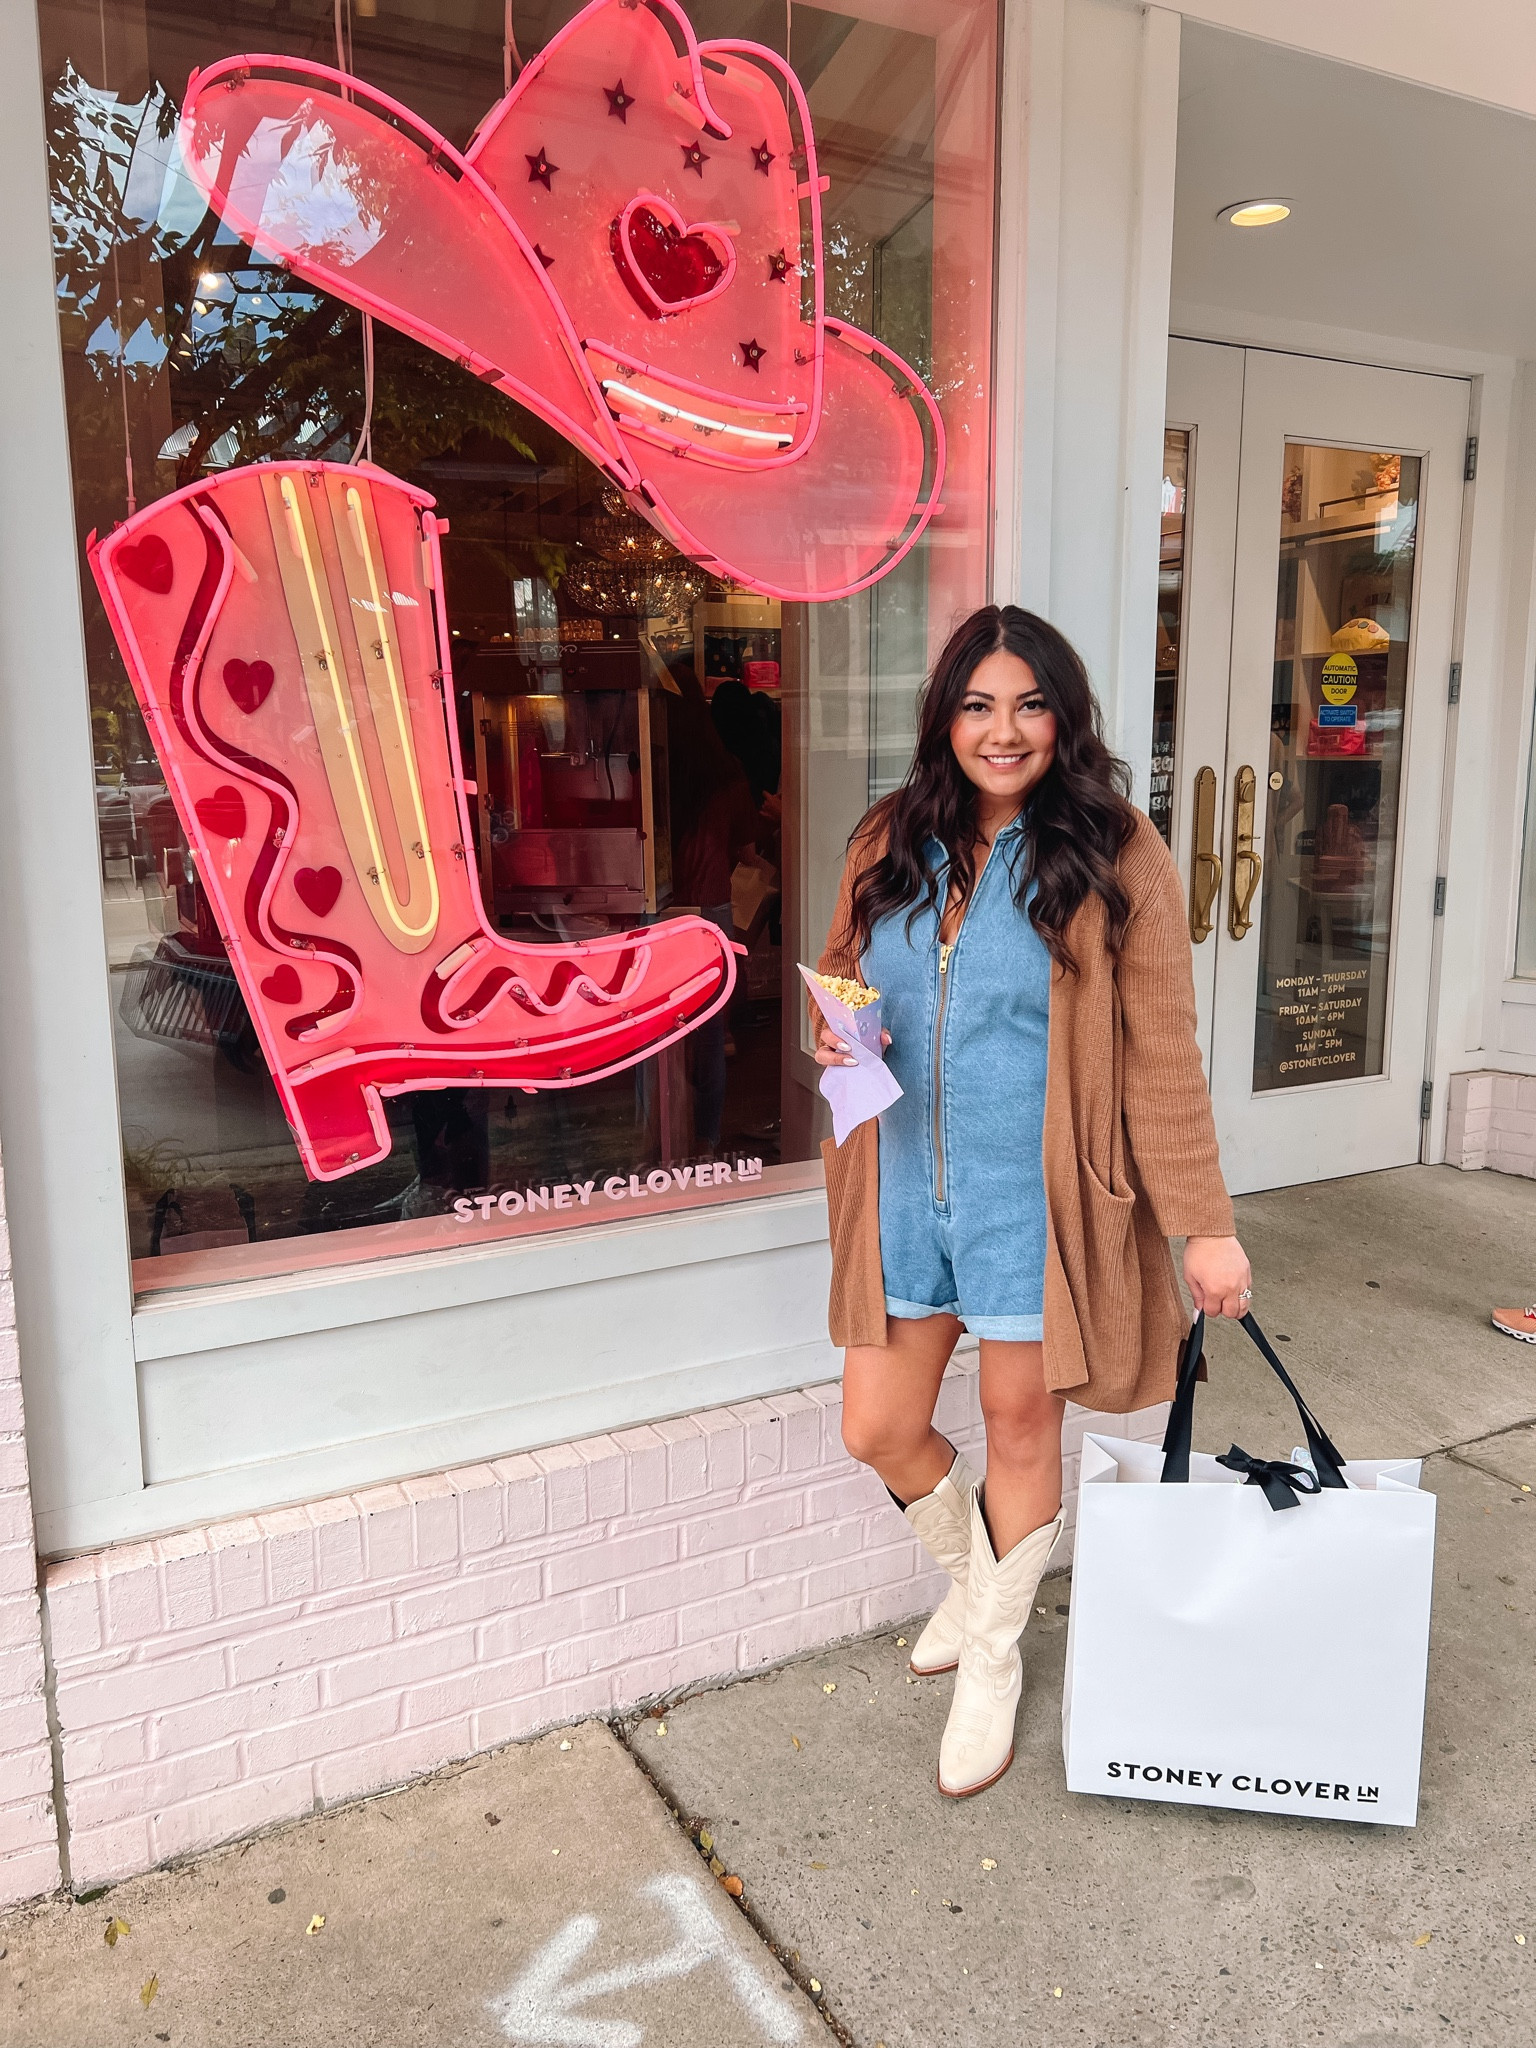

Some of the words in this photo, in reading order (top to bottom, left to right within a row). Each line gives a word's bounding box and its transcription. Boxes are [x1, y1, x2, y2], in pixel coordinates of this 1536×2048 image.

[1324, 664, 1357, 672] AUTOMATIC
[1322, 675, 1357, 685] CAUTION
[1276, 975, 1315, 989] MONDAY
[1322, 969, 1367, 983] THURSDAY
[1298, 987, 1319, 997] 11AM
[1327, 984, 1345, 994] 6PM
[1279, 1004, 1310, 1016] FRIDAY
[1318, 998, 1362, 1011] SATURDAY
[1296, 1015, 1318, 1026] 10AM
[1327, 1011, 1345, 1022] 6PM
[1302, 1028, 1337, 1040] SUNDAY
[1295, 1042, 1316, 1053] 11AM
[1325, 1039, 1343, 1049] 5PM
[1279, 1052, 1356, 1073] @STONEYCLOVER
[453, 1180, 595, 1223] STONEY
[603, 1161, 733, 1200] CLOVER
[737, 1157, 763, 1180] LN
[1107, 1761, 1223, 1788] STONEY
[1232, 1775, 1350, 1801] CLOVER
[1357, 1785, 1379, 1801] LN
